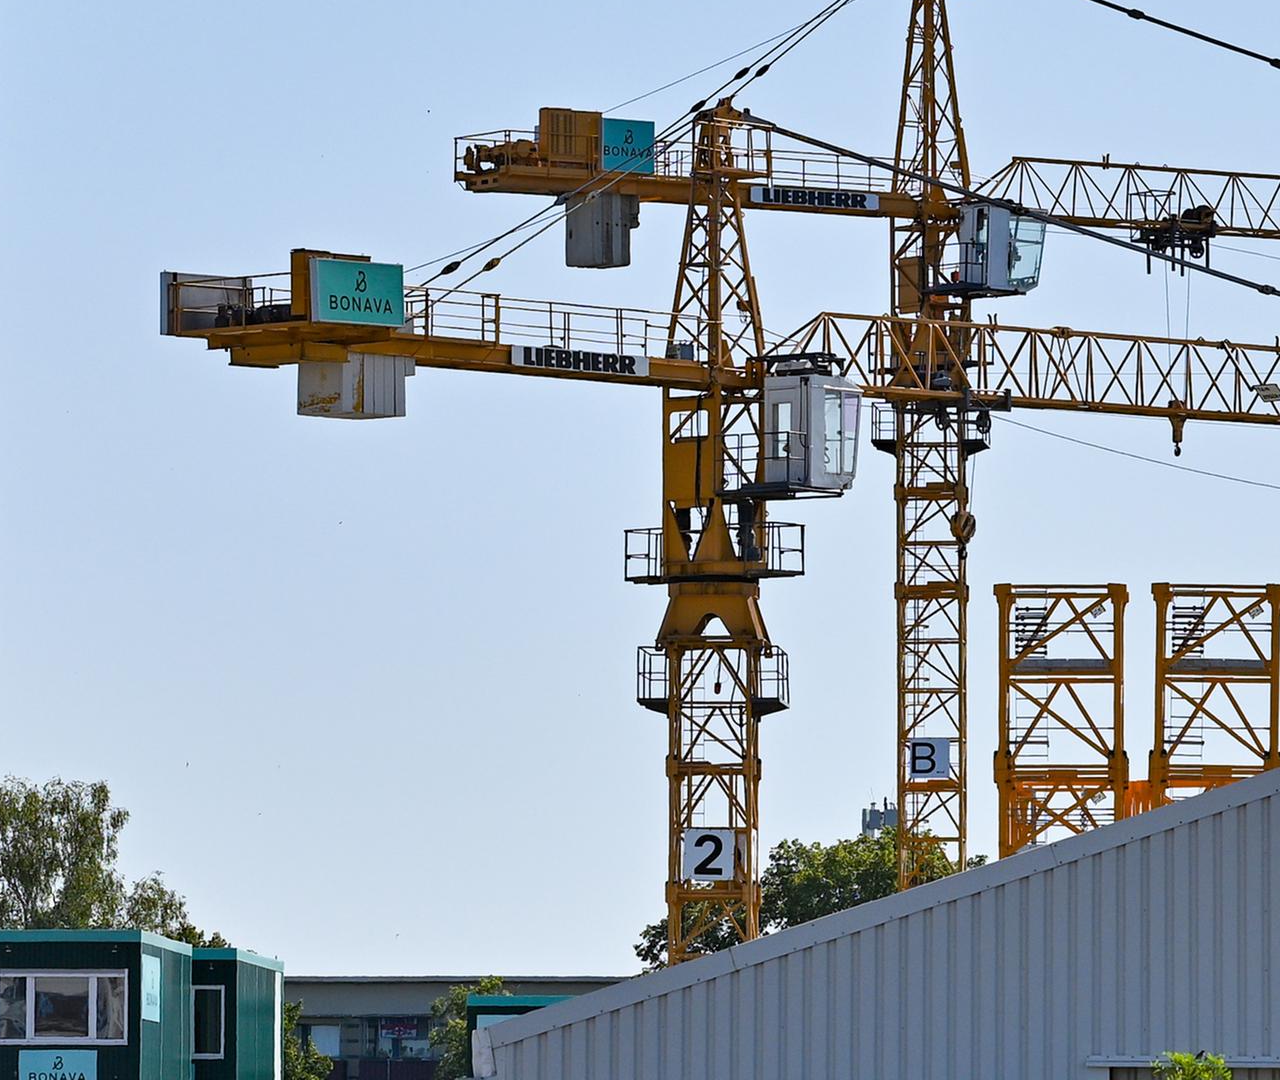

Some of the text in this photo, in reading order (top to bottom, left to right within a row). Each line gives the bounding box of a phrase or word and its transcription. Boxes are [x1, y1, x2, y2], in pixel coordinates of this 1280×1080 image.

[762, 187, 867, 209] LIEBHERR
[329, 295, 393, 314] BONAVA
[523, 346, 636, 375] LIEBHERR
[912, 742, 936, 774] B
[694, 834, 723, 875] 2
[28, 1072, 86, 1080] BONAVA
